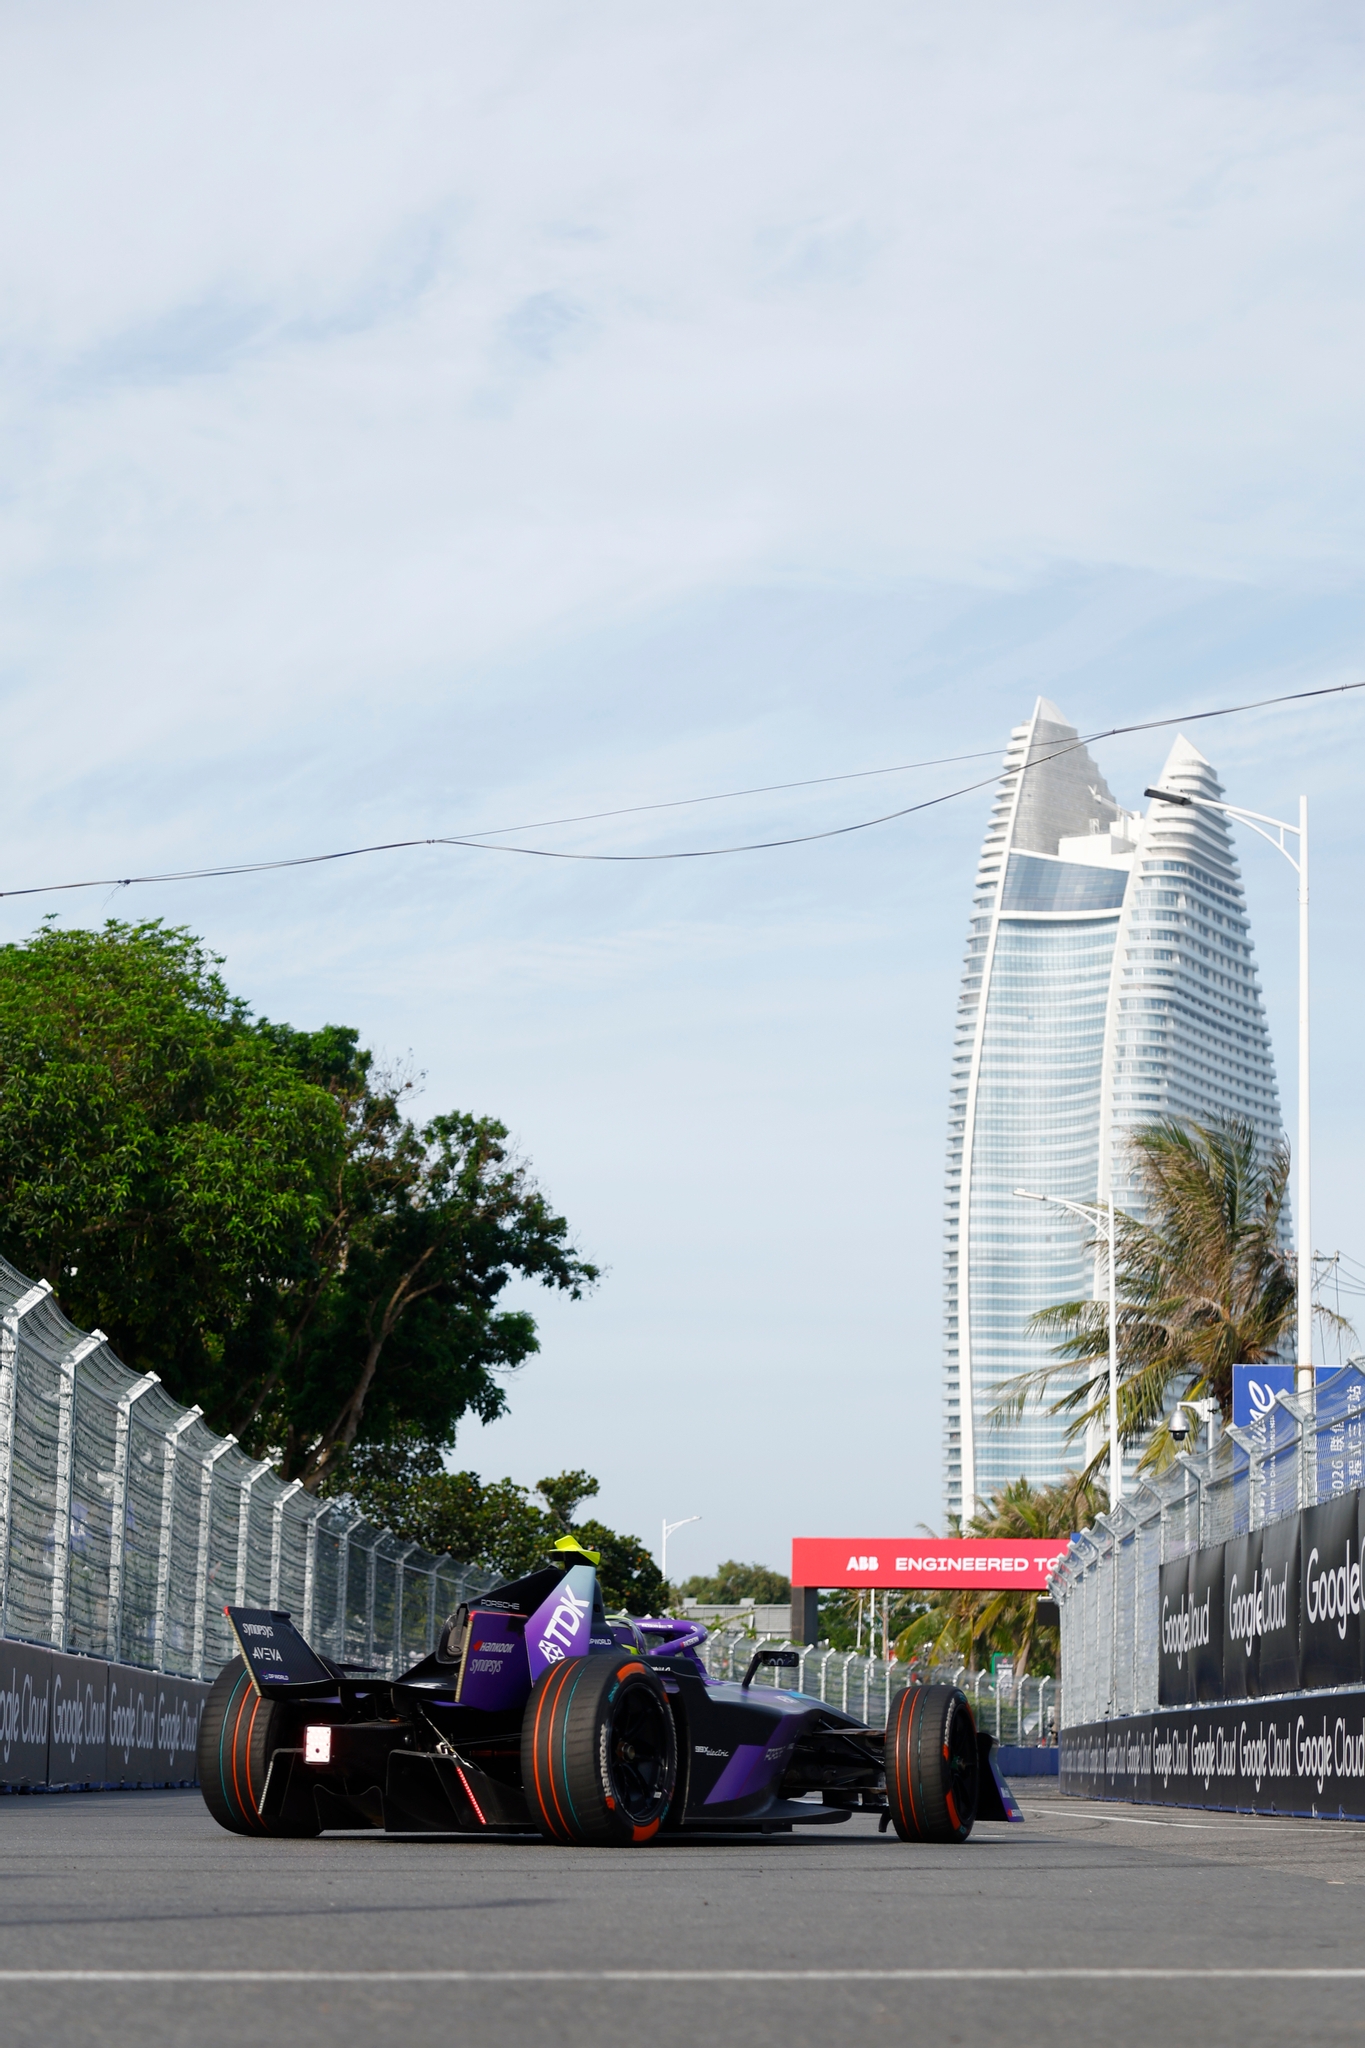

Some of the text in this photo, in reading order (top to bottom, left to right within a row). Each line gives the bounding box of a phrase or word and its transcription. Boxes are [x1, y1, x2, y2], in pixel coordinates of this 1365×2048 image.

[846, 1556, 879, 1571] ABB
[895, 1557, 1029, 1572] ENGINEERED
[1306, 1538, 1361, 1640] Google
[242, 1623, 274, 1638] SYNOPSYS
[481, 1599, 520, 1610] PORSCHE
[543, 1584, 590, 1648] TDK
[1162, 1586, 1211, 1671] Google Cloud
[1229, 1570, 1262, 1658] Google
[1261, 1561, 1288, 1634] Cloud
[252, 1646, 283, 1662] AVEVA
[469, 1658, 503, 1675] SYNOPSYS
[21, 1673, 49, 1745] Cloud
[53, 1674, 83, 1764] Google
[84, 1683, 107, 1745] Cloud
[109, 1682, 135, 1765] Google
[136, 1692, 156, 1749] Cloud
[157, 1692, 180, 1767] Google
[180, 1700, 199, 1752] Cloud
[1153, 1726, 1172, 1789] Google
[1172, 1728, 1189, 1775] Cloud
[1191, 1723, 1237, 1791] Google Cloud
[1239, 1720, 1291, 1793] Google Cloud
[1296, 1714, 1365, 1795] Google Cloud
